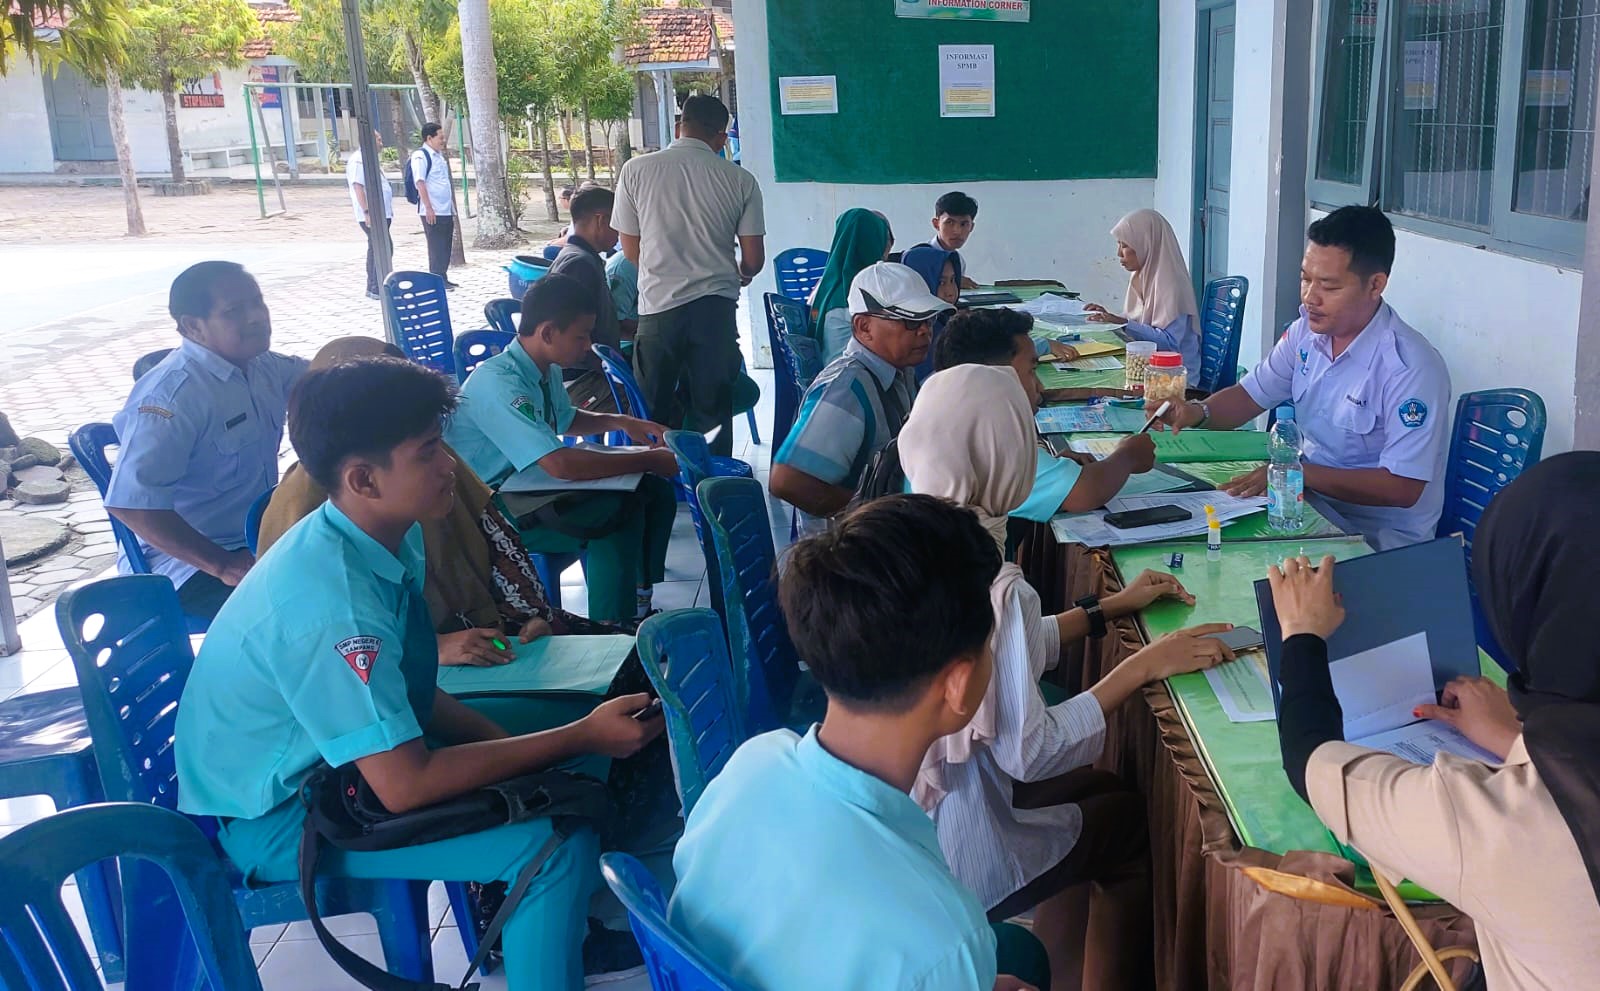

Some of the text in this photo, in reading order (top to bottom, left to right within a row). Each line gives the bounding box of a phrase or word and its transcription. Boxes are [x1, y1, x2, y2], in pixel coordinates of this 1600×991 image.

[928, 0, 1024, 10] INFORMATION CORNER
[946, 53, 988, 61] INFORMASI
[358, 656, 368, 667] IX
